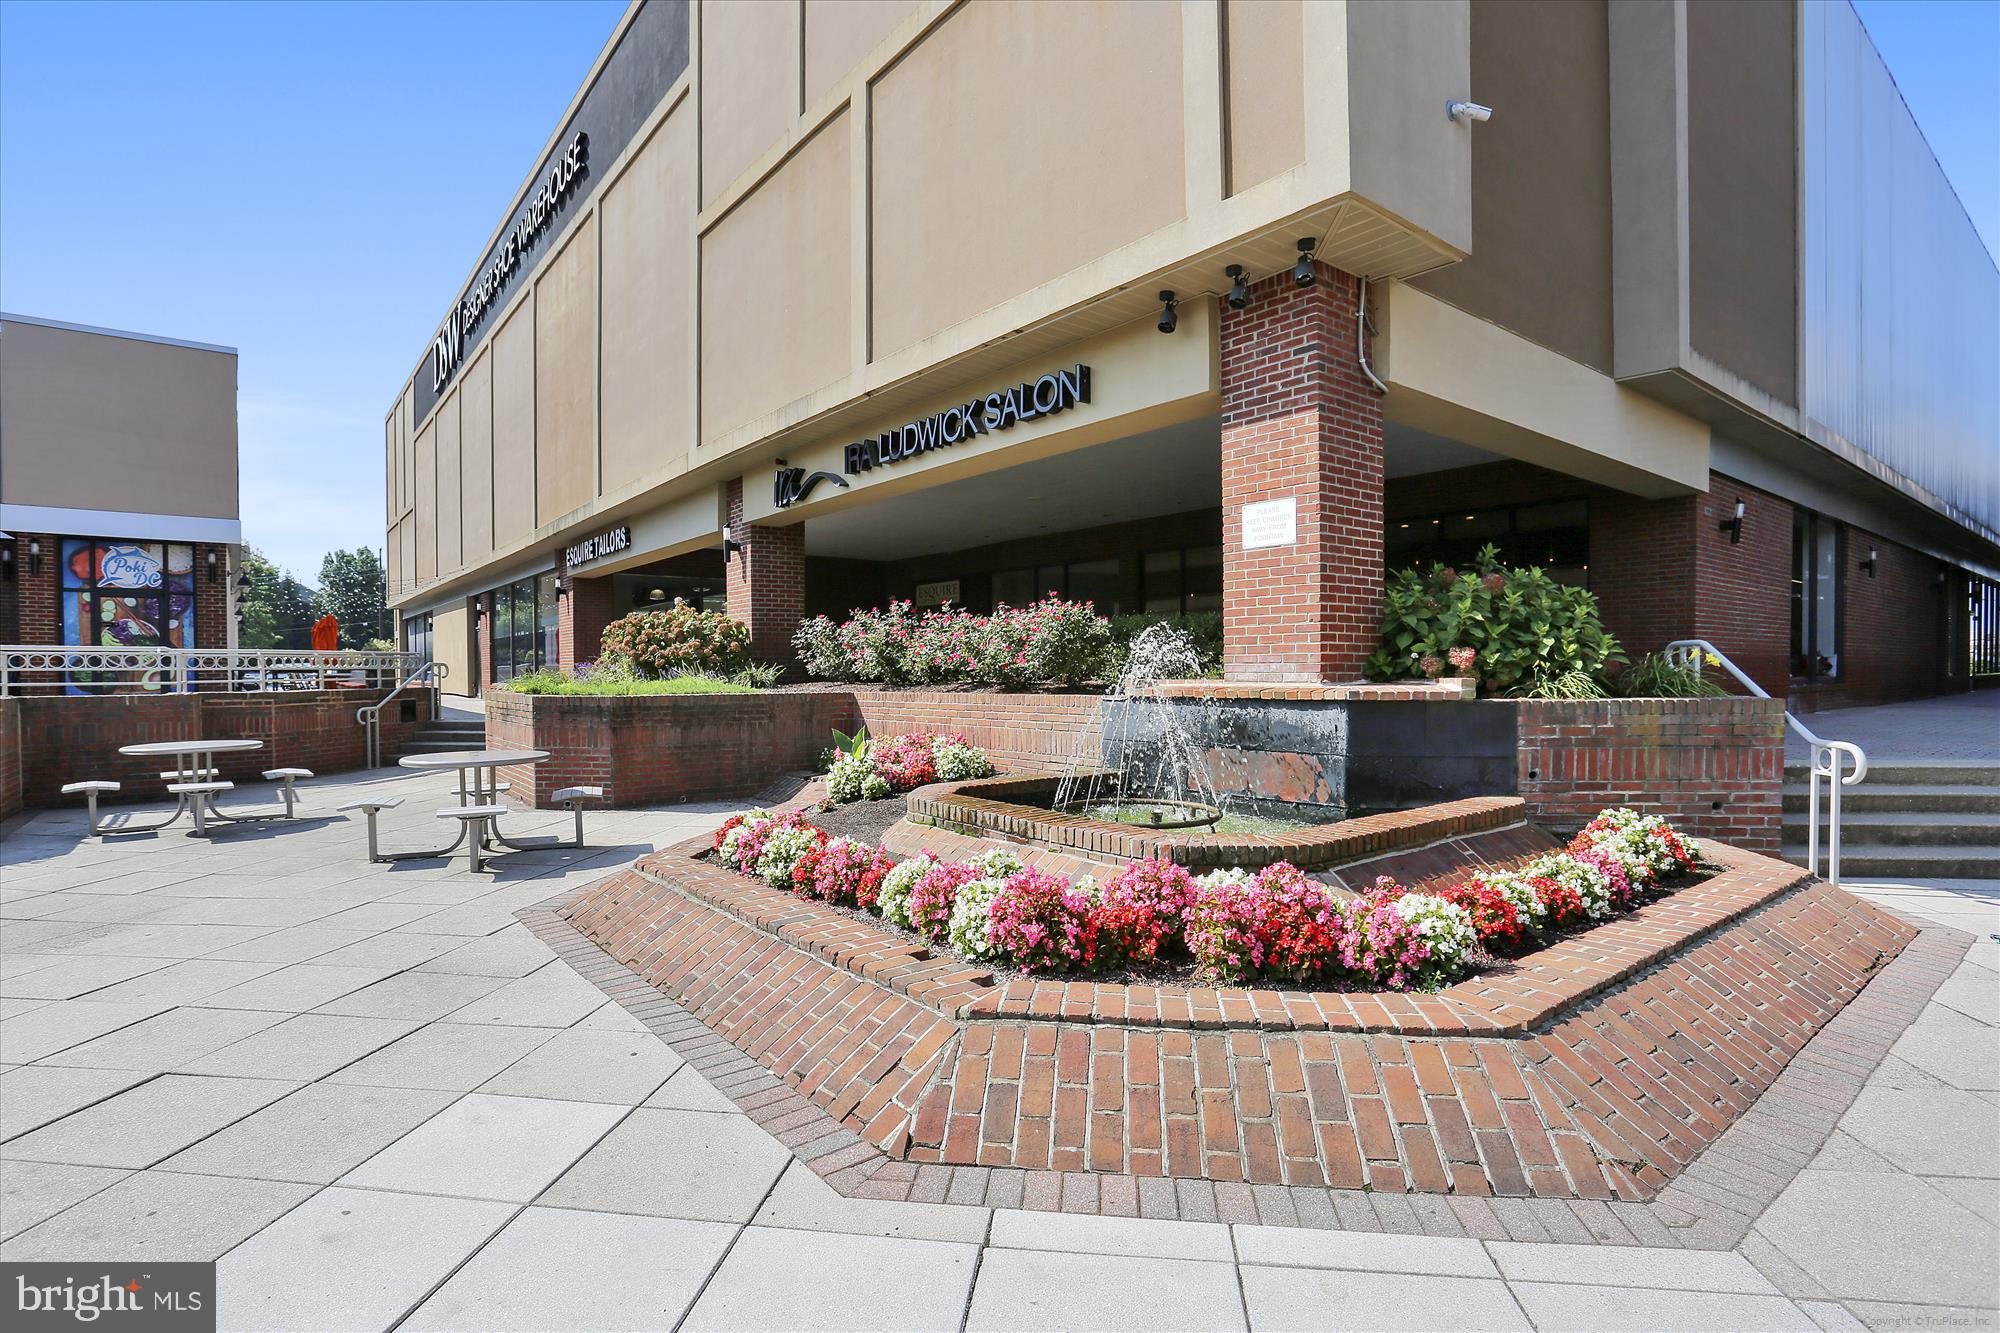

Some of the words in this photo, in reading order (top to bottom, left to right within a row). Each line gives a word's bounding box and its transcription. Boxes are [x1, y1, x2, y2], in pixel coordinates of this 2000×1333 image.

[433, 300, 463, 392] DSW
[462, 268, 493, 335] DESIGNER
[494, 232, 516, 288] SHOE
[516, 131, 580, 250] WAREHOUSE
[844, 439, 879, 475] IRA
[879, 400, 980, 463] LUDWICK
[984, 363, 1084, 430] SALON
[566, 538, 594, 567] ESQUIRE
[594, 526, 627, 558] TAILORS
[111, 557, 147, 575] Poki
[133, 572, 161, 586] DC
[918, 582, 959, 600] ESQUIRE
